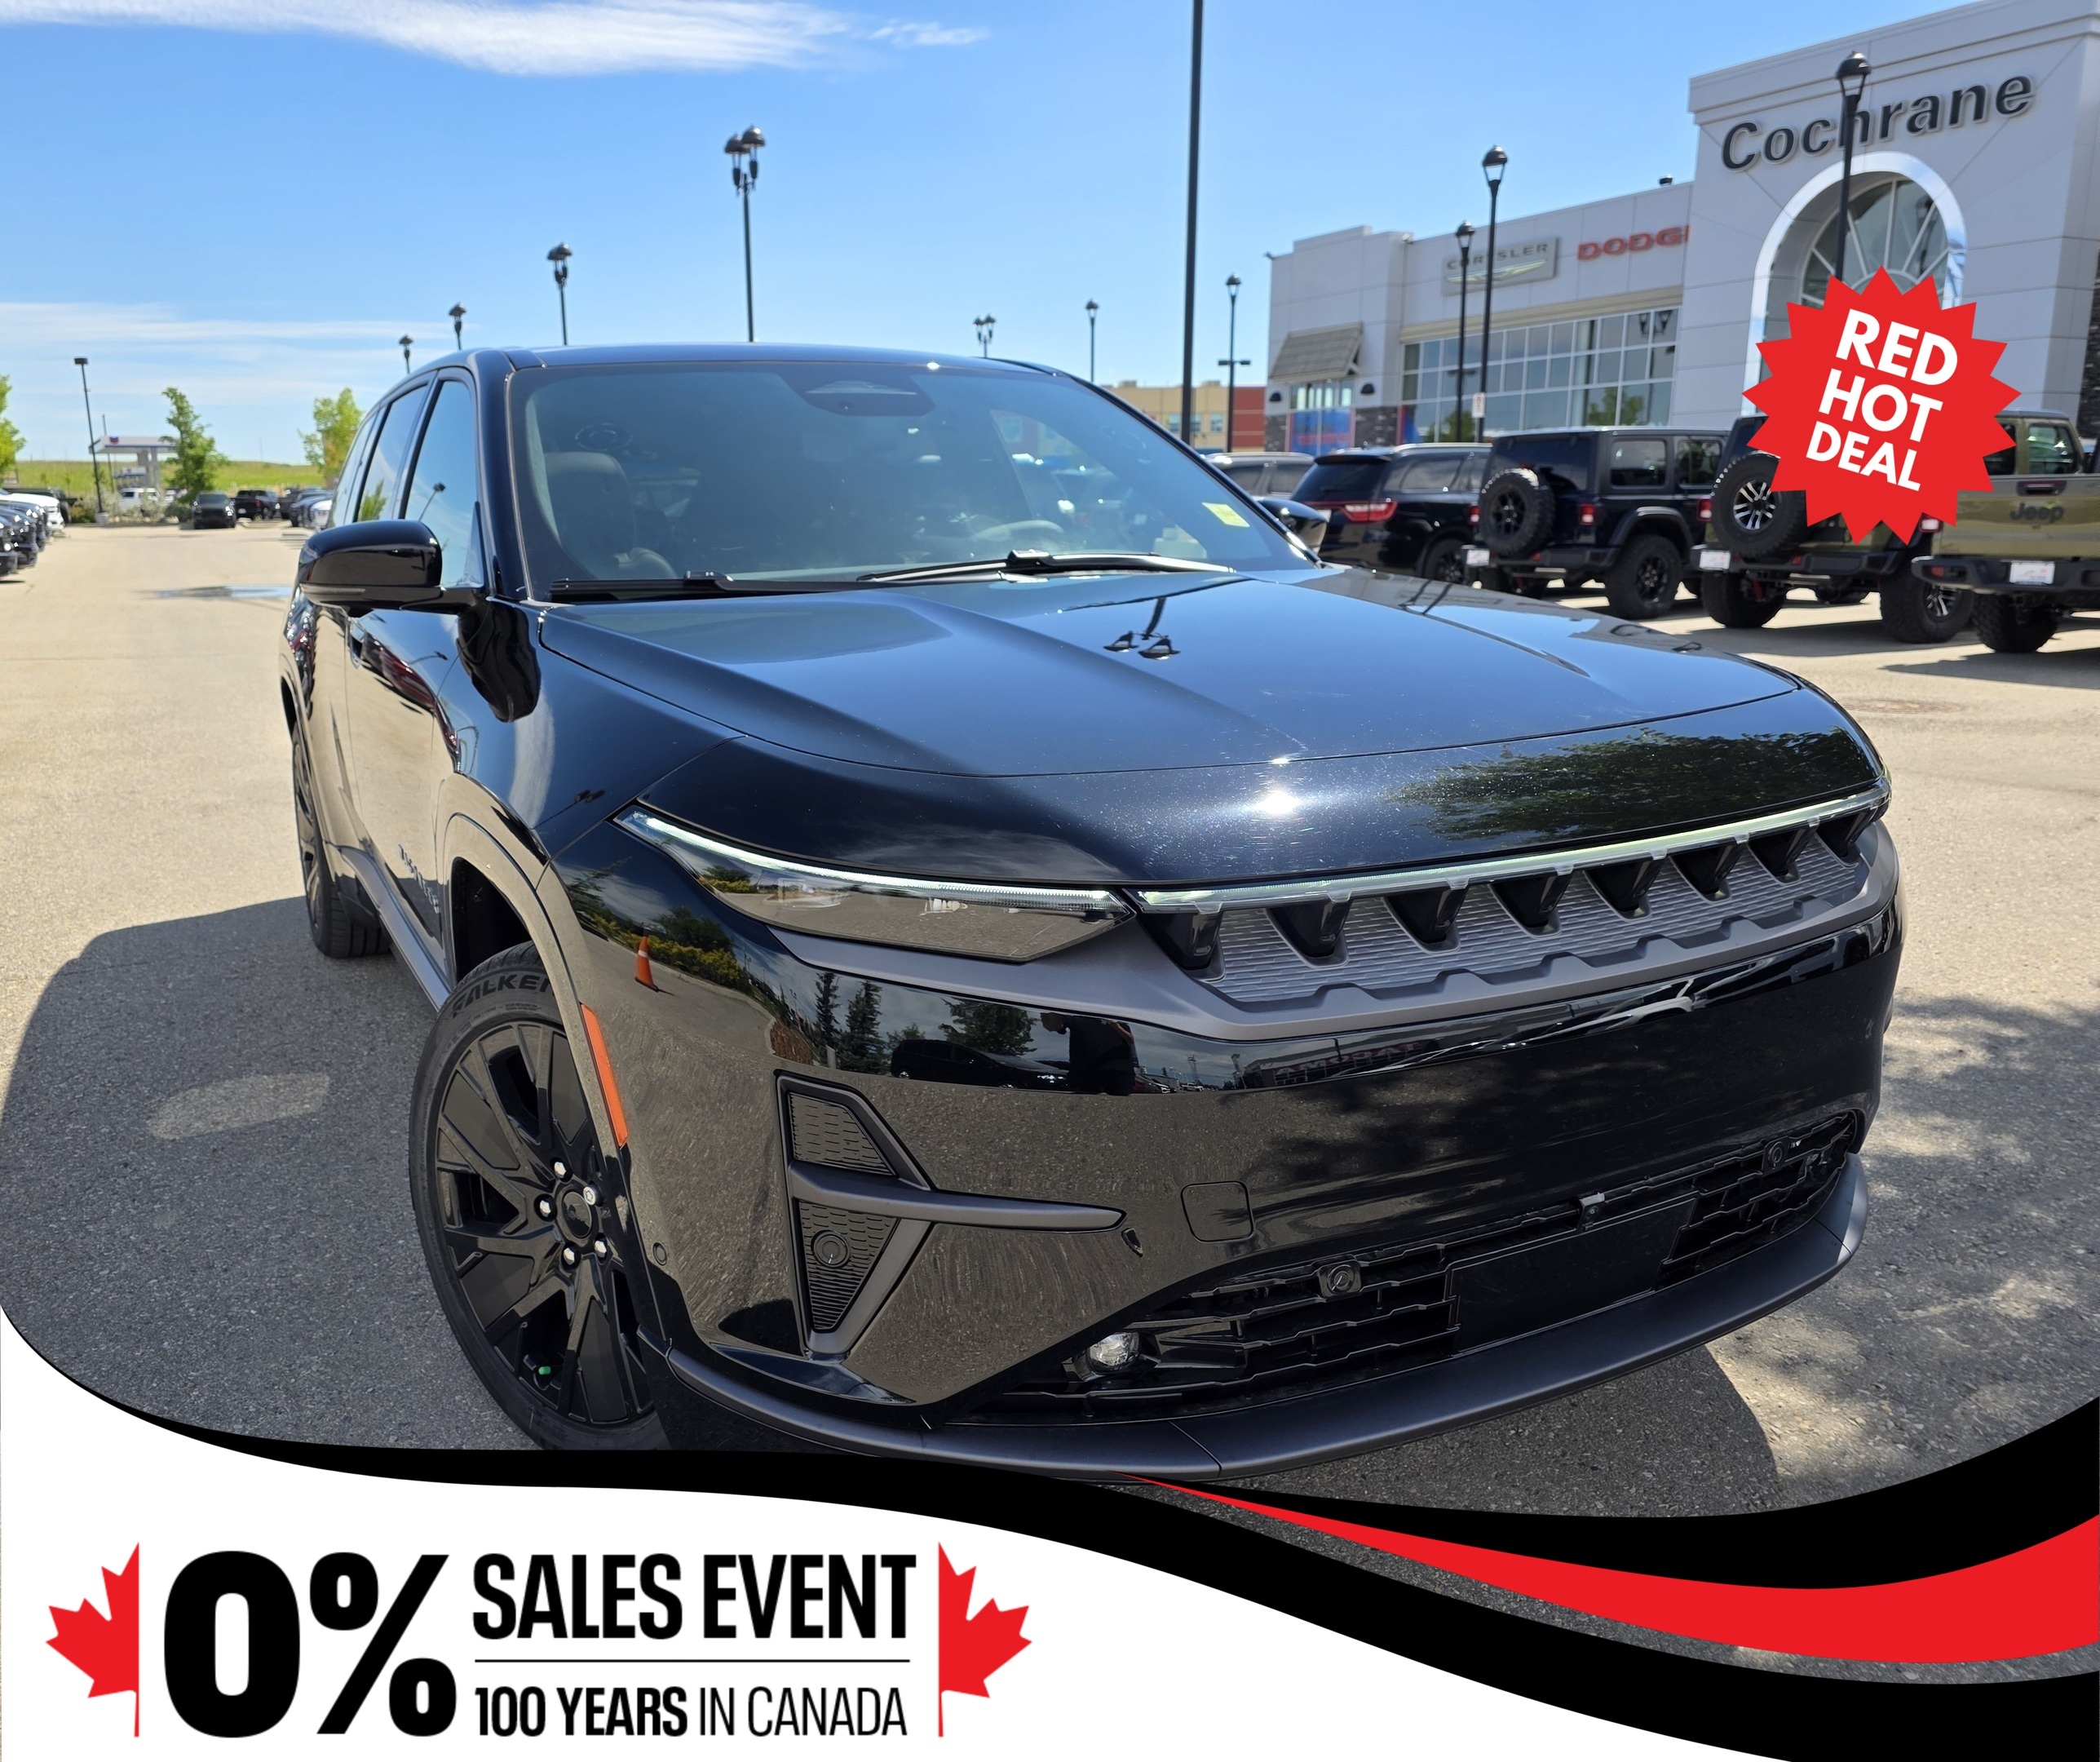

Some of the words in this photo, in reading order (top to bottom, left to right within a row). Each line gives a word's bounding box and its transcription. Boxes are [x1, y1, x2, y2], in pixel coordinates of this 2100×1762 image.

[1722, 75, 2033, 170] Cochrane
[1447, 243, 1548, 270] CRSLER
[1577, 224, 1689, 260] DODG
[2009, 502, 2065, 525] Jeep
